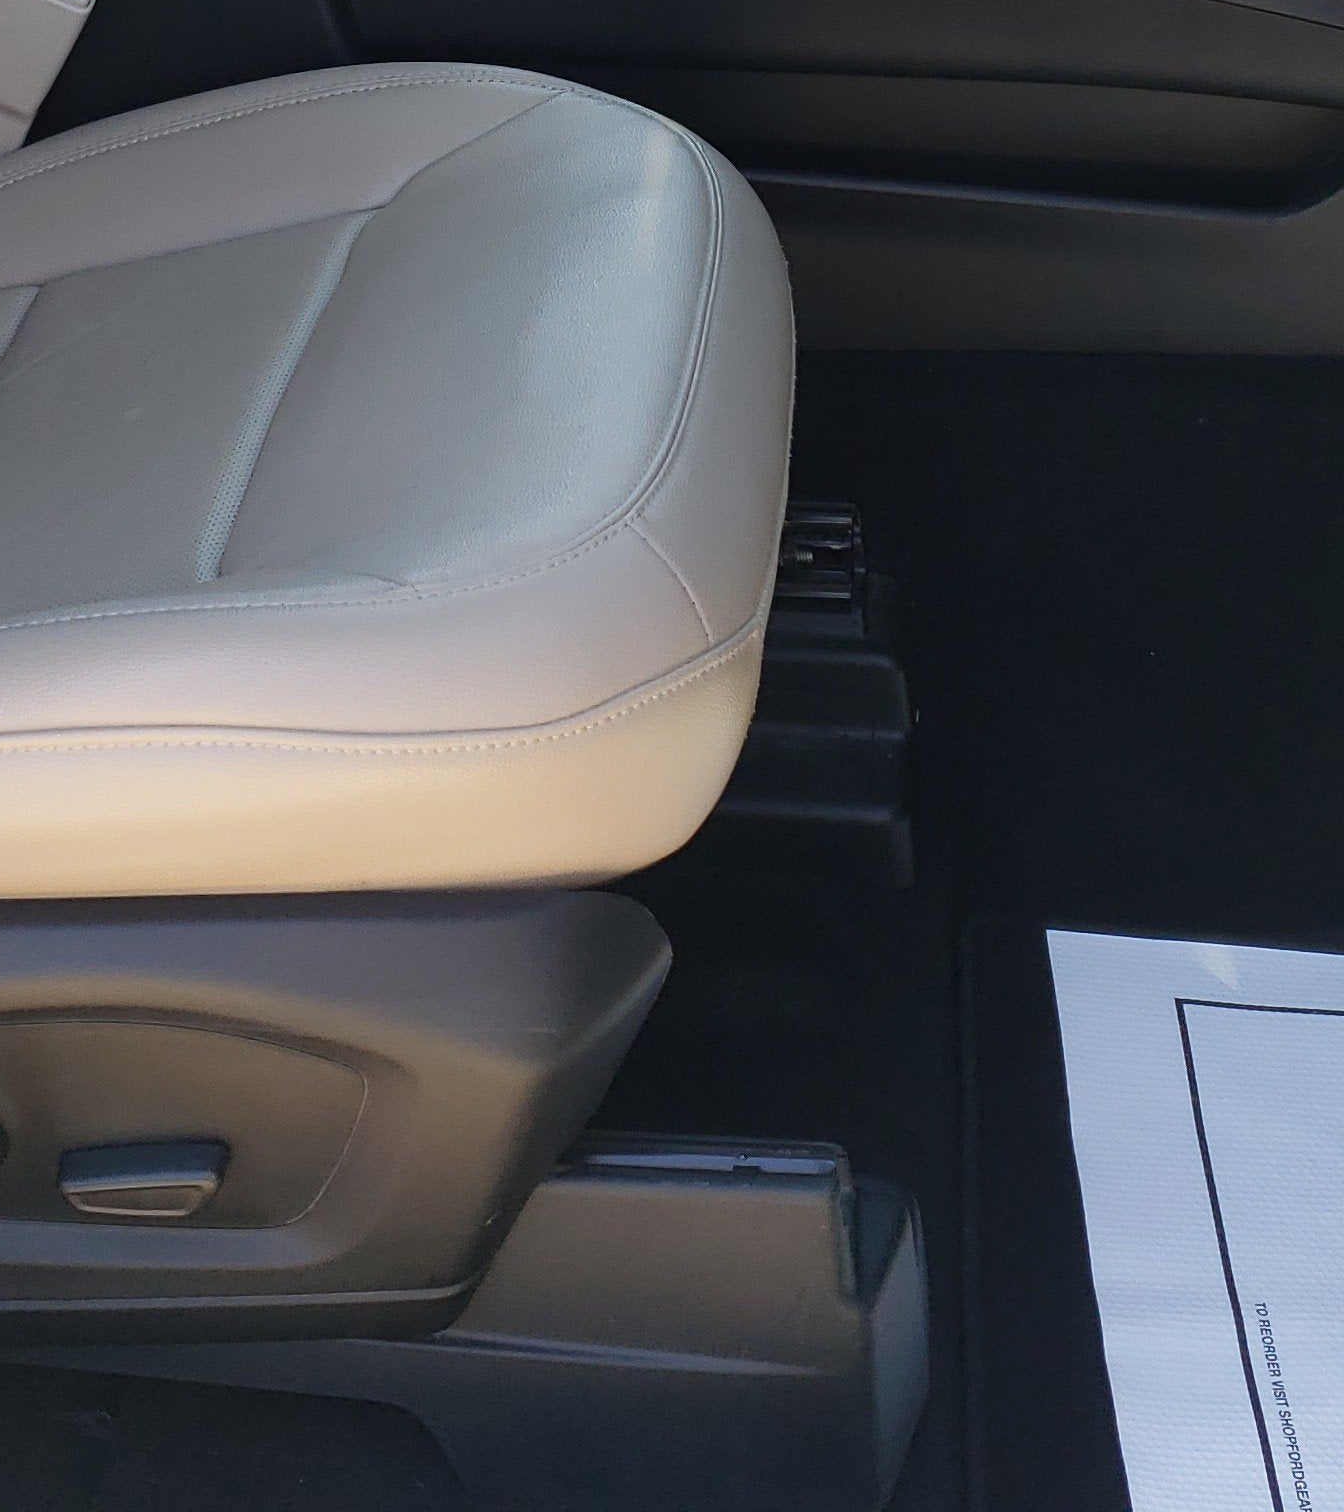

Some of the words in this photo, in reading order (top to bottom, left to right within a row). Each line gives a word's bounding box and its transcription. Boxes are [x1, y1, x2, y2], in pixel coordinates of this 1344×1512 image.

[1255, 1302, 1269, 1317] TO
[1261, 1319, 1282, 1378] REORDER
[1272, 1380, 1290, 1408] VISIT
